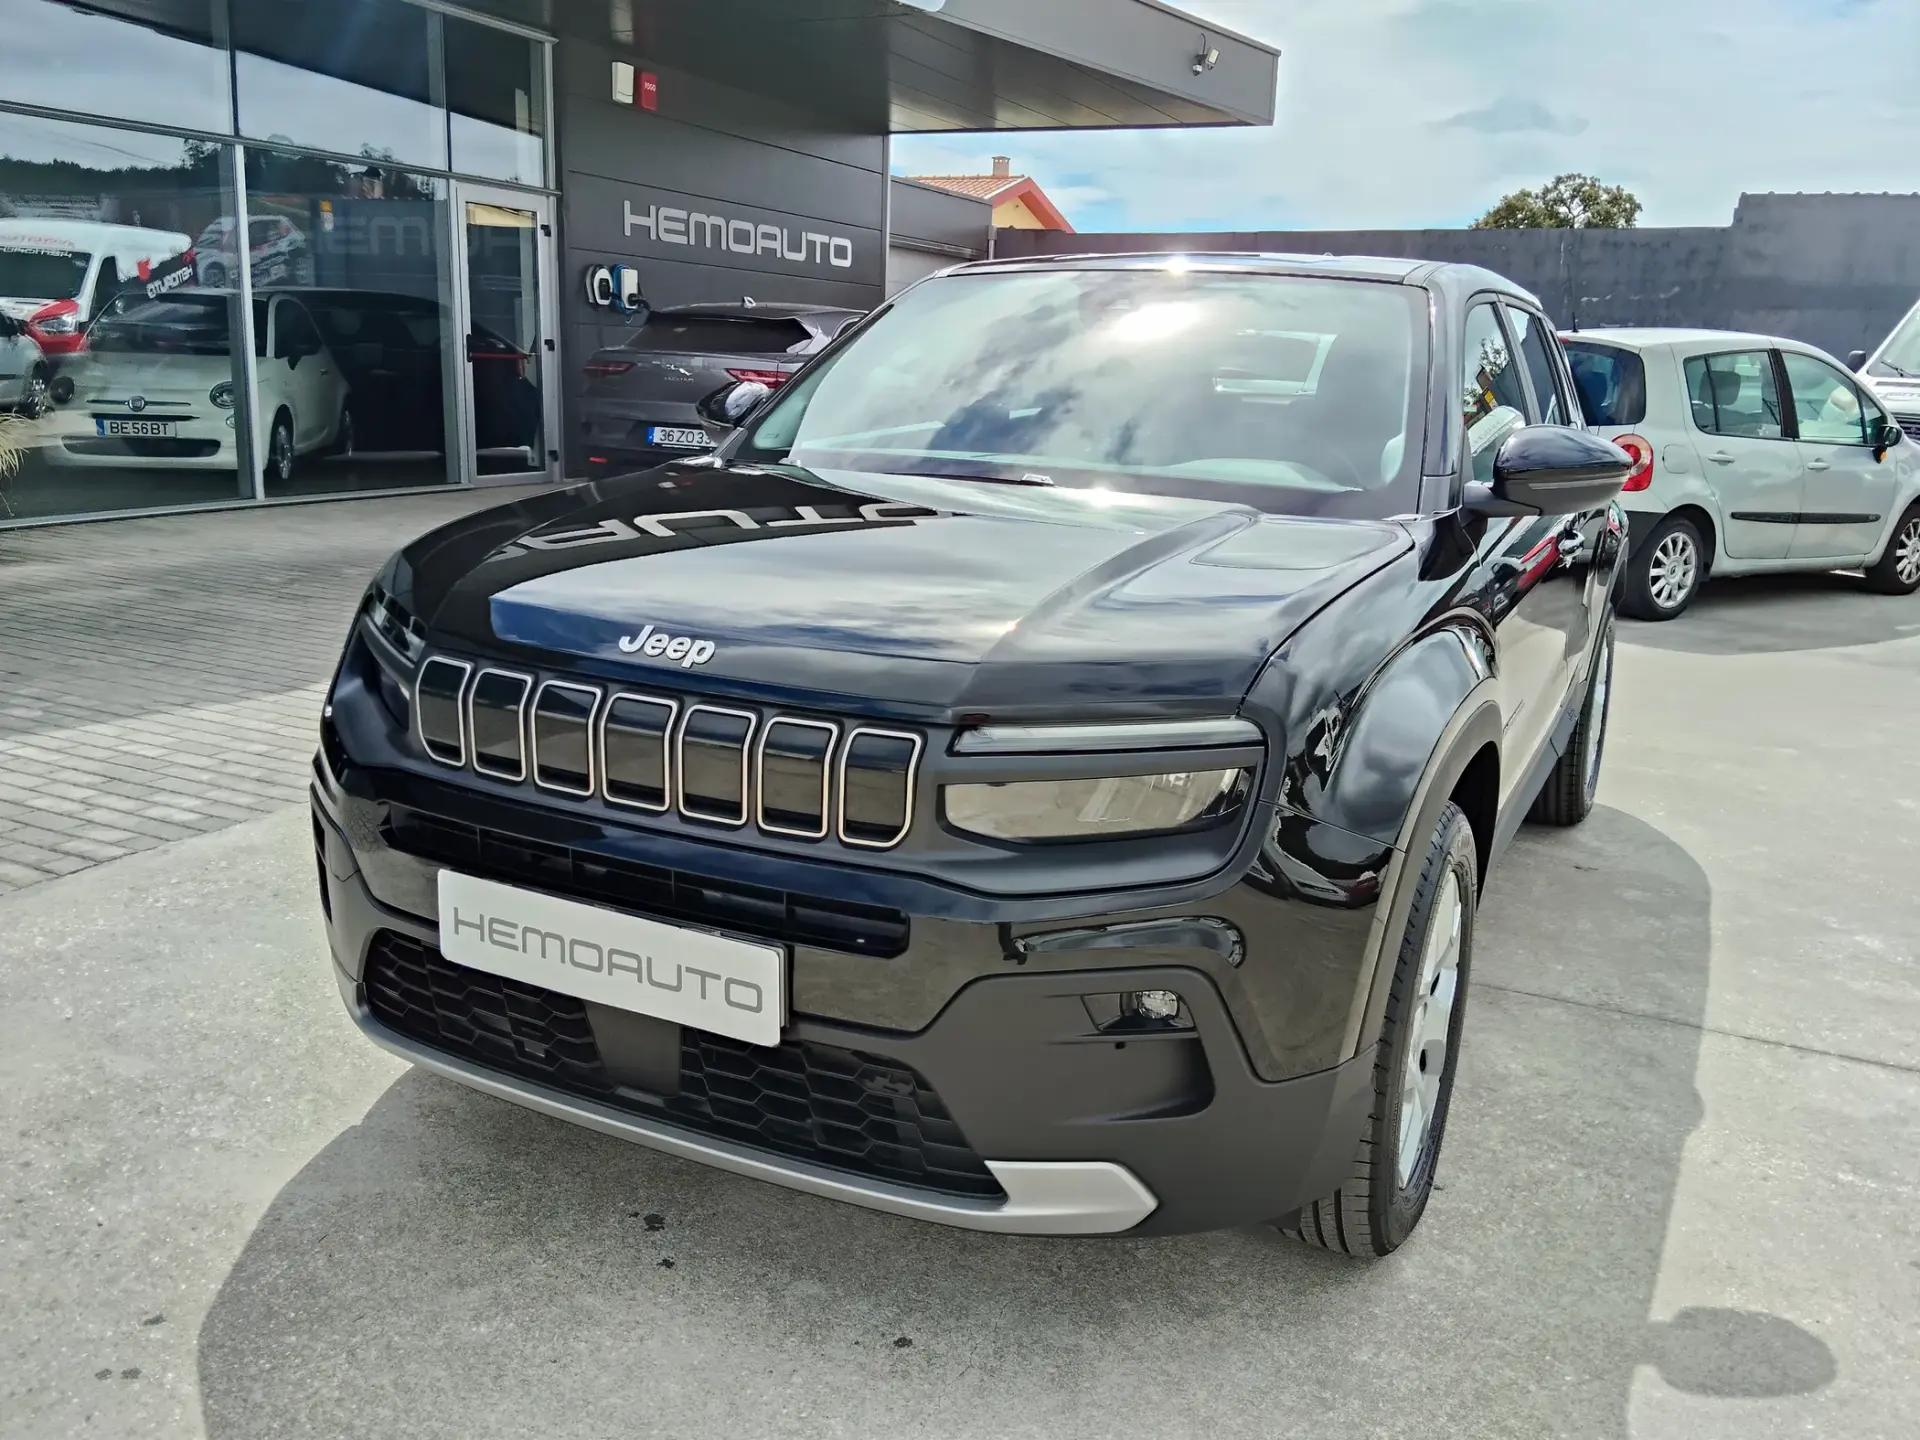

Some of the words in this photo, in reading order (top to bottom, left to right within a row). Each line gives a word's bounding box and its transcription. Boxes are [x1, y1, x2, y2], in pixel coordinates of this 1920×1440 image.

[623, 200, 852, 268] HEMOAUTO
[618, 625, 716, 668] Jeep
[453, 906, 763, 1014] HEMOAUTO
